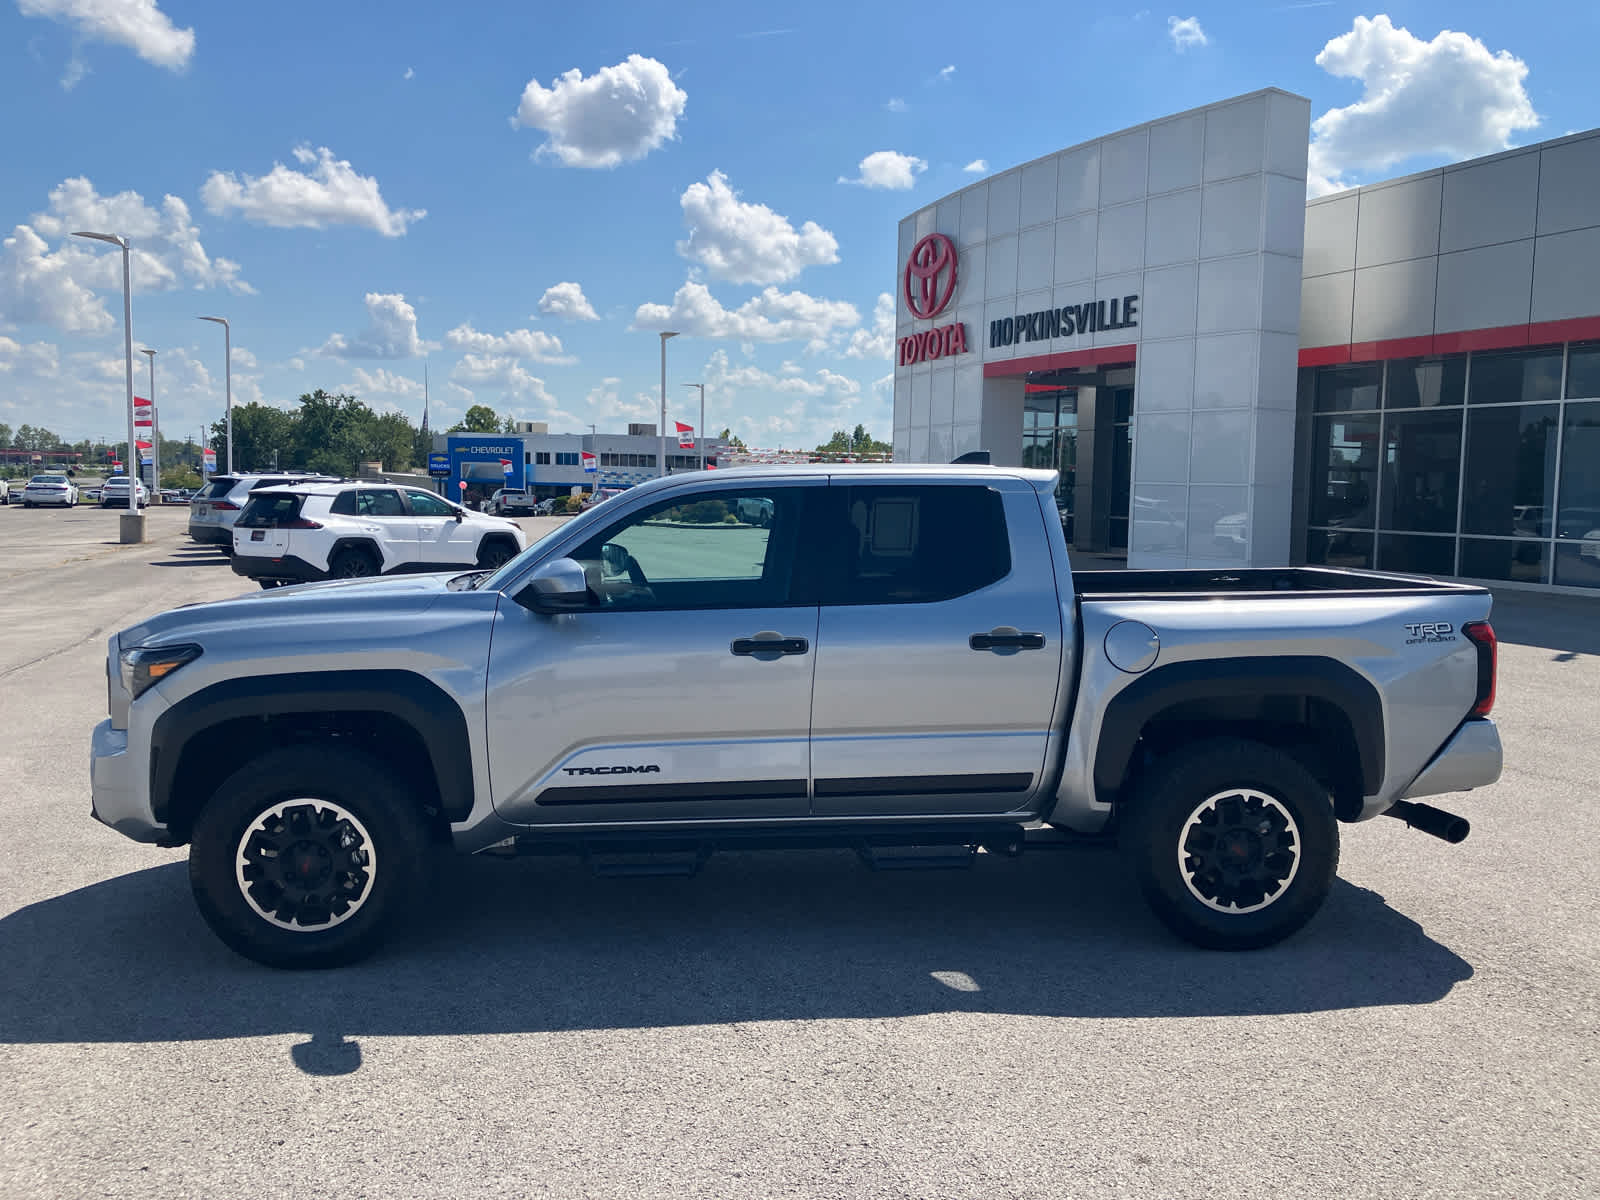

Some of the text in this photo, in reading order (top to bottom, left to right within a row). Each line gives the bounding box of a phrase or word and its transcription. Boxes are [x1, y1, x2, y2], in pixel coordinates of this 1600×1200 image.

[989, 295, 1139, 348] HOPKINSVILLE
[897, 322, 967, 366] TOYOTA
[470, 446, 514, 454] CHEVROLET
[1405, 622, 1453, 638] TRD
[562, 765, 661, 776] TACOMA
